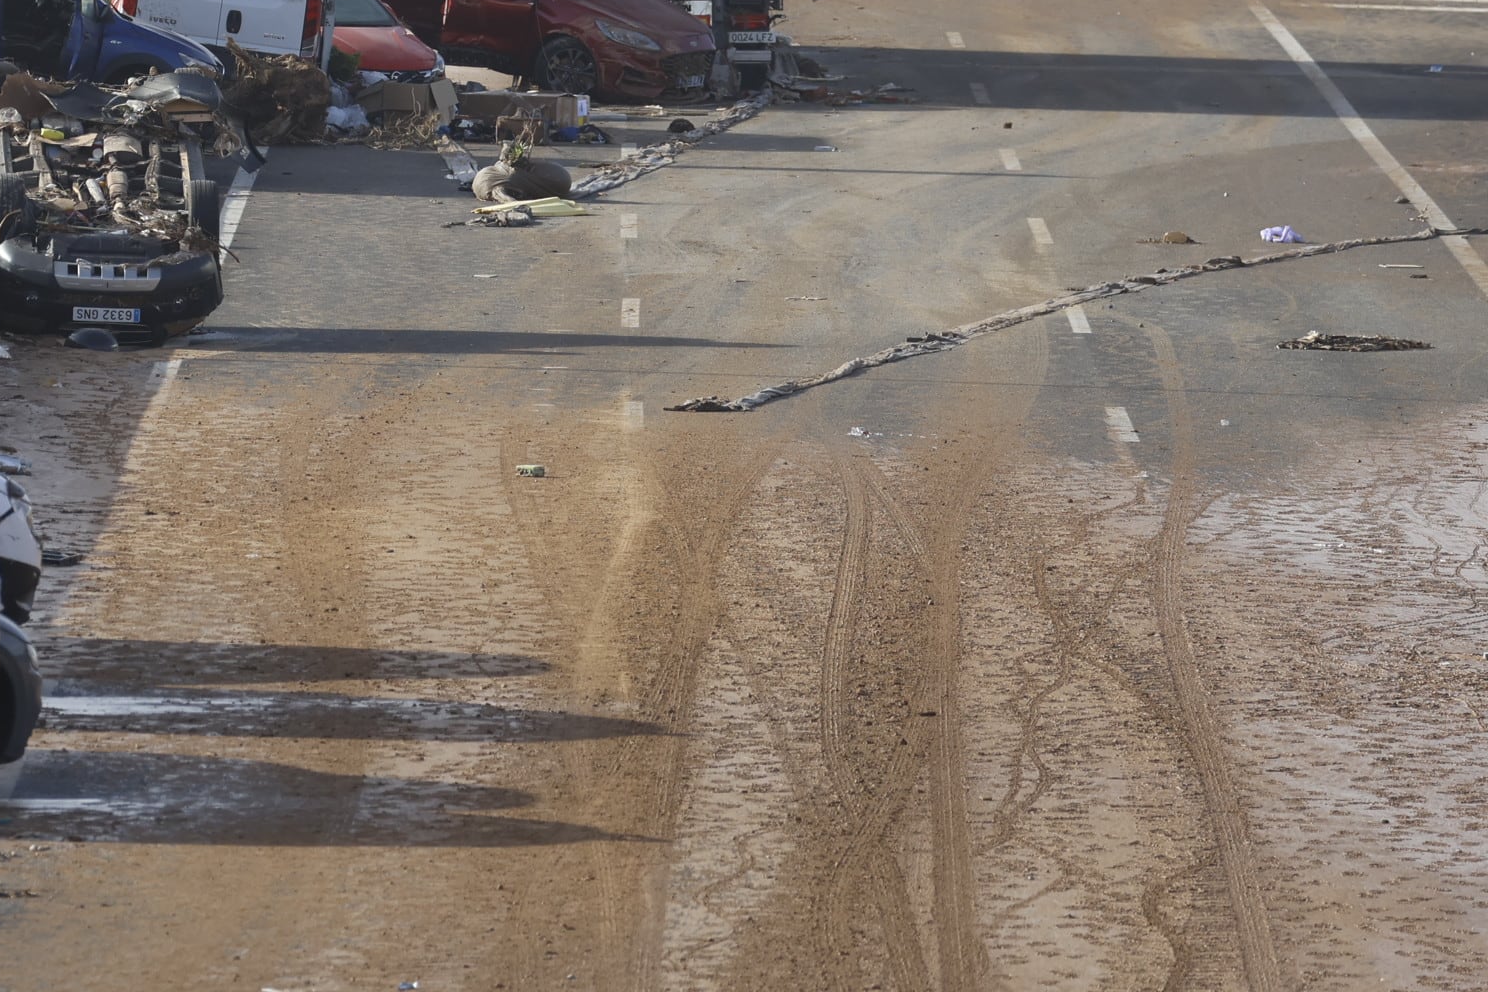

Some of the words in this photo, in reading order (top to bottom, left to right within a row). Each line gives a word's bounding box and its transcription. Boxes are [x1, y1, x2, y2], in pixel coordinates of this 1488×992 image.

[731, 33, 754, 42] 0024
[755, 32, 774, 42] LFZ
[76, 308, 99, 320] GNS
[102, 309, 132, 321] 6332
